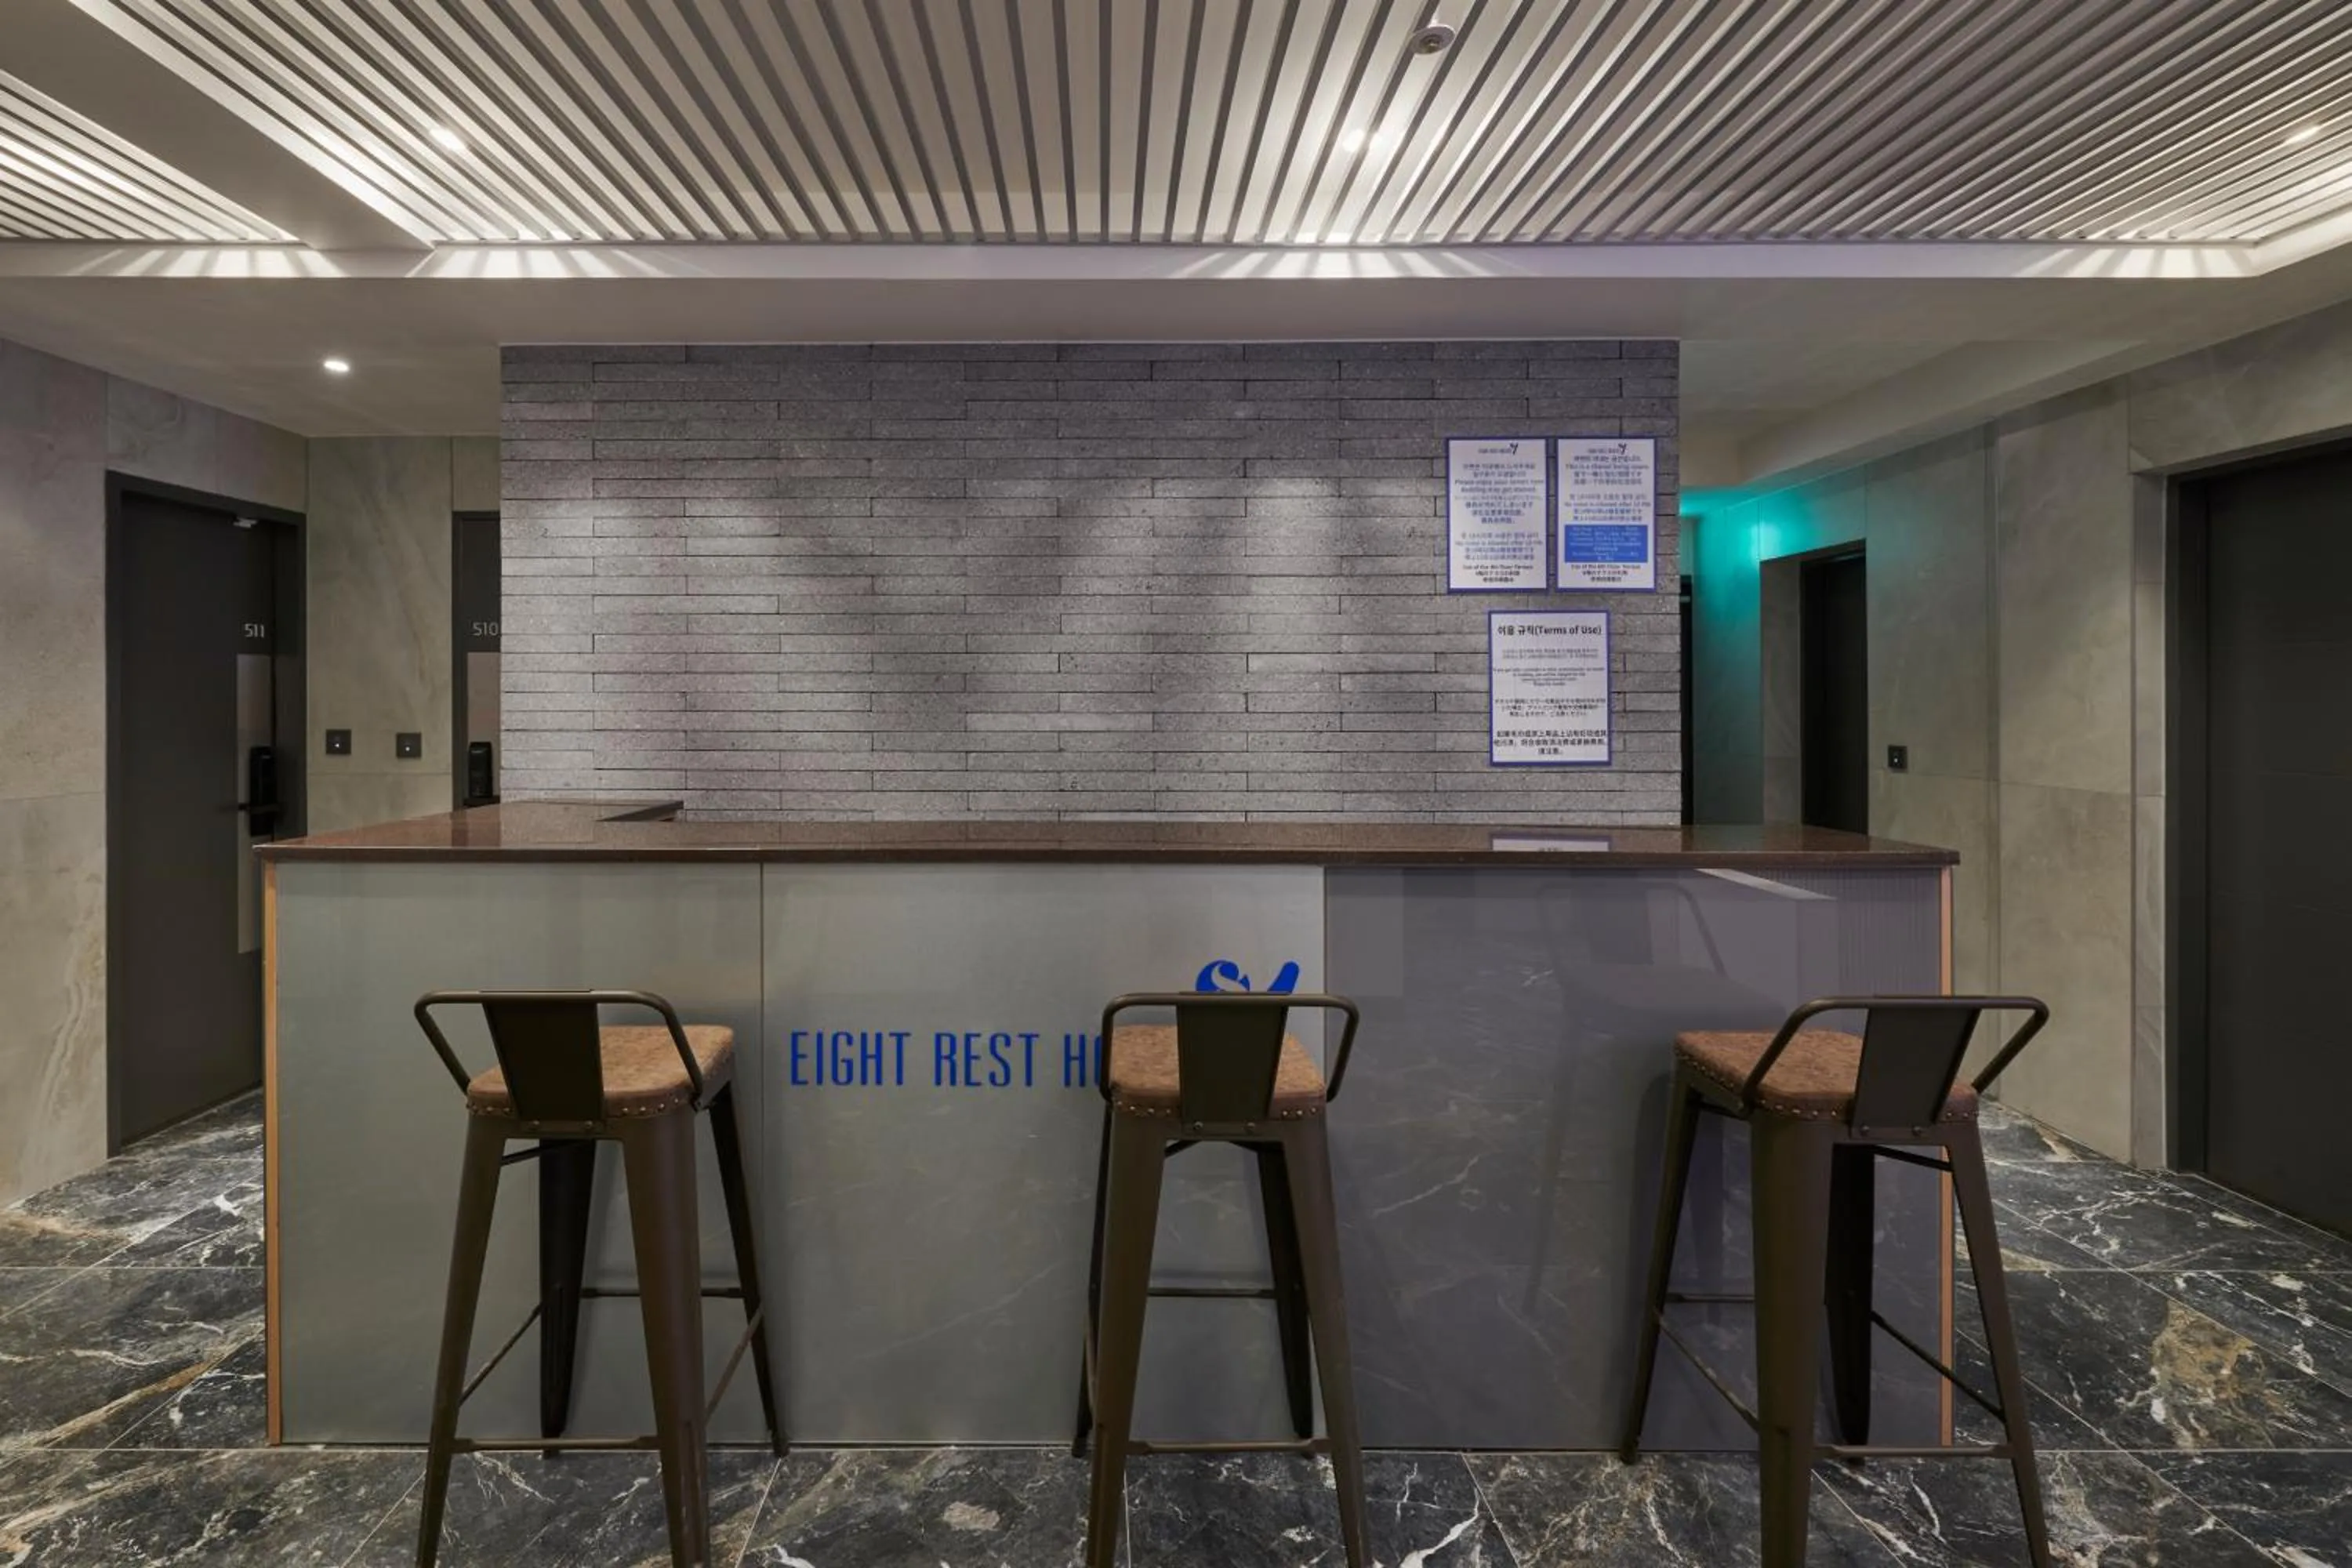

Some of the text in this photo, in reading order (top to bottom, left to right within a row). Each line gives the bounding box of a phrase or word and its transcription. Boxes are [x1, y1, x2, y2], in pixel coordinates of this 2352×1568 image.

[245, 623, 265, 638] 511
[473, 622, 499, 637] 510
[1569, 625, 1579, 634] of
[1581, 625, 1602, 636] Use)
[790, 1031, 912, 1085] EIGHT
[935, 1033, 1040, 1087] REST
